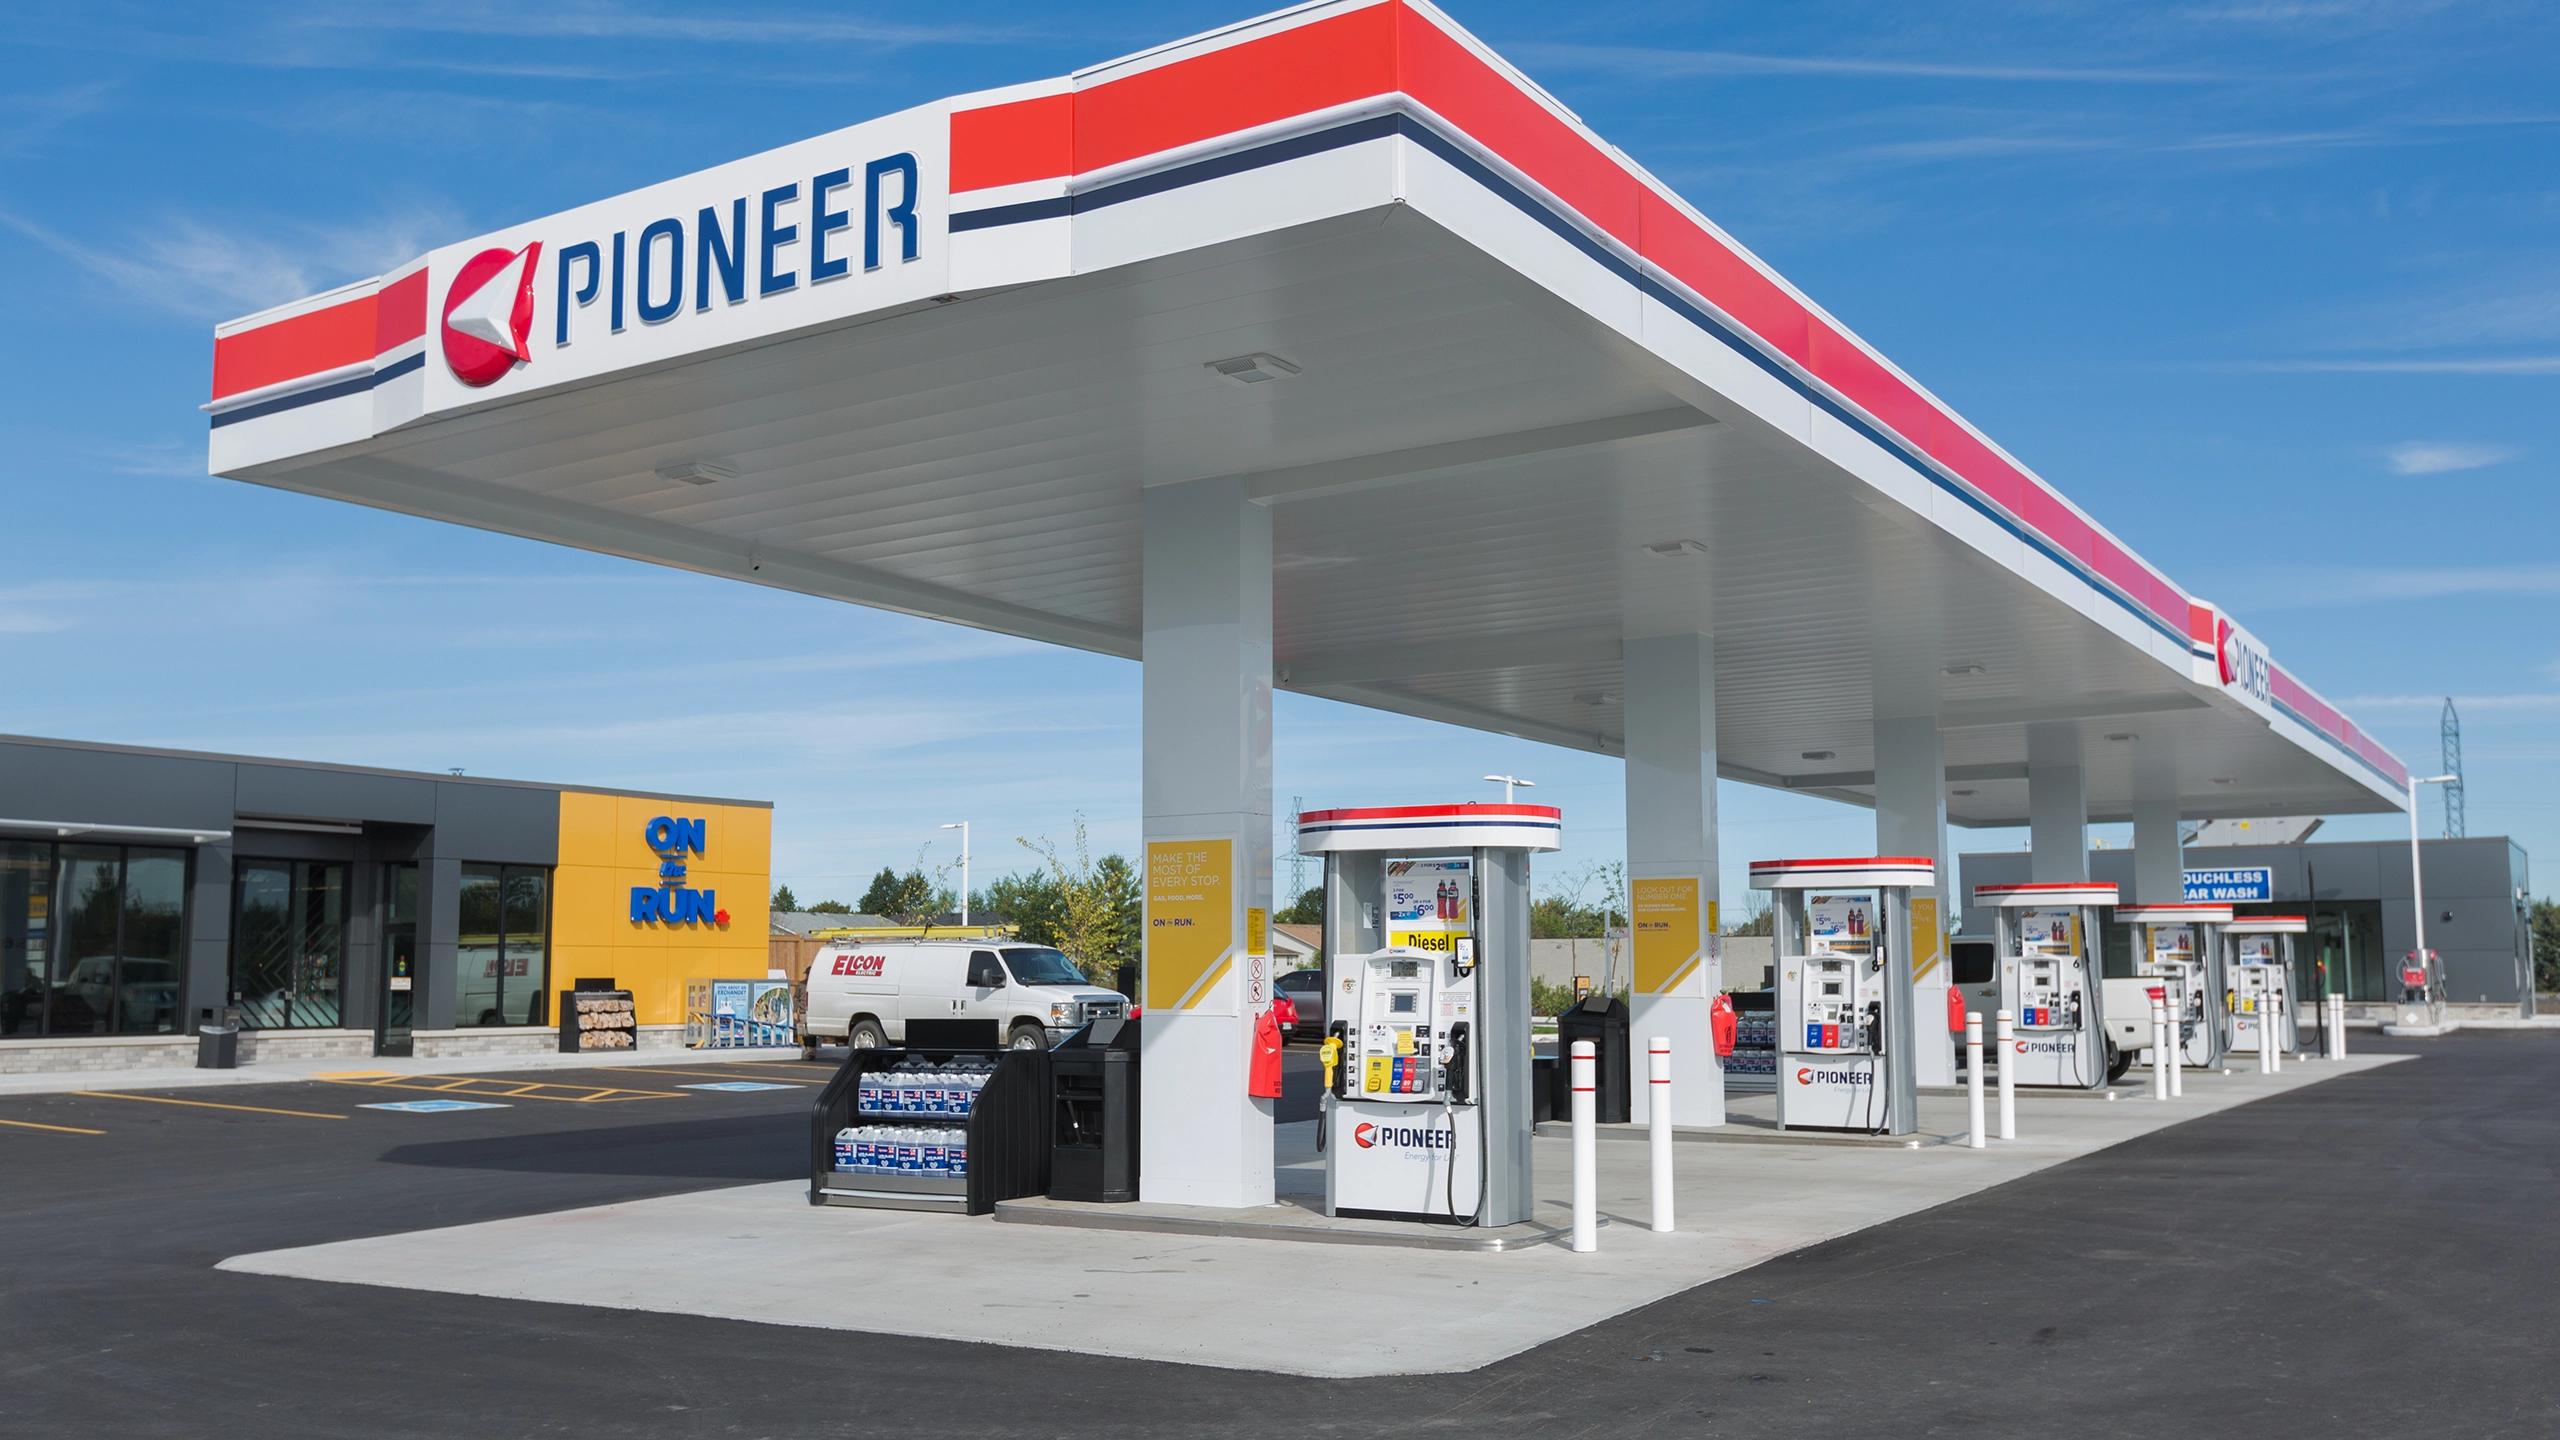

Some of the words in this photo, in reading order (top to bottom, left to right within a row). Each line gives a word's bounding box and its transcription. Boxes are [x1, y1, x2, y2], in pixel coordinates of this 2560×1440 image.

[556, 150, 921, 349] PIONEER
[645, 816, 706, 852] ON
[1153, 852, 1183, 864] MAKE
[1187, 851, 1207, 863] THE
[1153, 865, 1182, 875] MOST
[1185, 864, 1200, 874] OF
[1153, 876, 1187, 888] EVERY
[1191, 875, 1220, 886] STOP.
[2183, 872, 2263, 884] OUCHLESS
[2212, 887, 2258, 898] WASH
[630, 887, 715, 924] RUN
[1153, 919, 1166, 927] ON
[1409, 934, 1449, 951] Diesel
[831, 955, 887, 976] ELCON
[2073, 960, 2080, 969] 6
[2031, 1042, 2075, 1053] PIONEER
[1817, 1071, 1872, 1085] PIONEER
[1404, 1152, 1428, 1162] Energy
